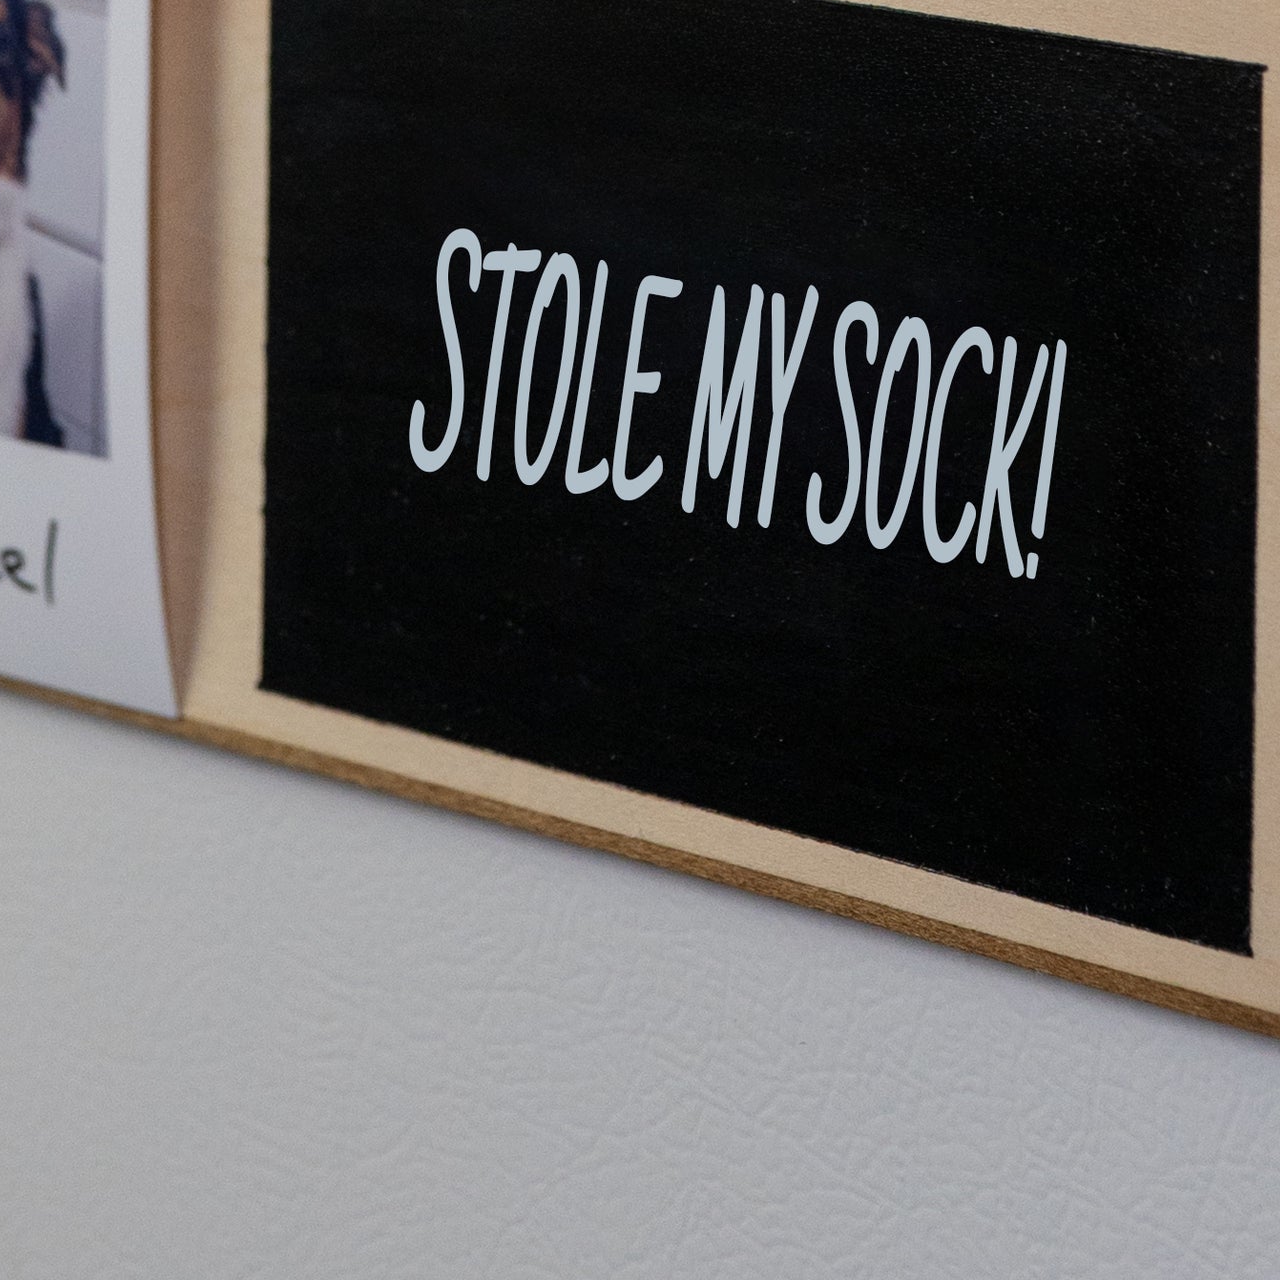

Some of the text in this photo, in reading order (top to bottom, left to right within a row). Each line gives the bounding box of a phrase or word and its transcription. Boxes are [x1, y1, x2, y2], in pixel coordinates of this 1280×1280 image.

[409, 229, 1068, 580] STOLE MY SOCK!
